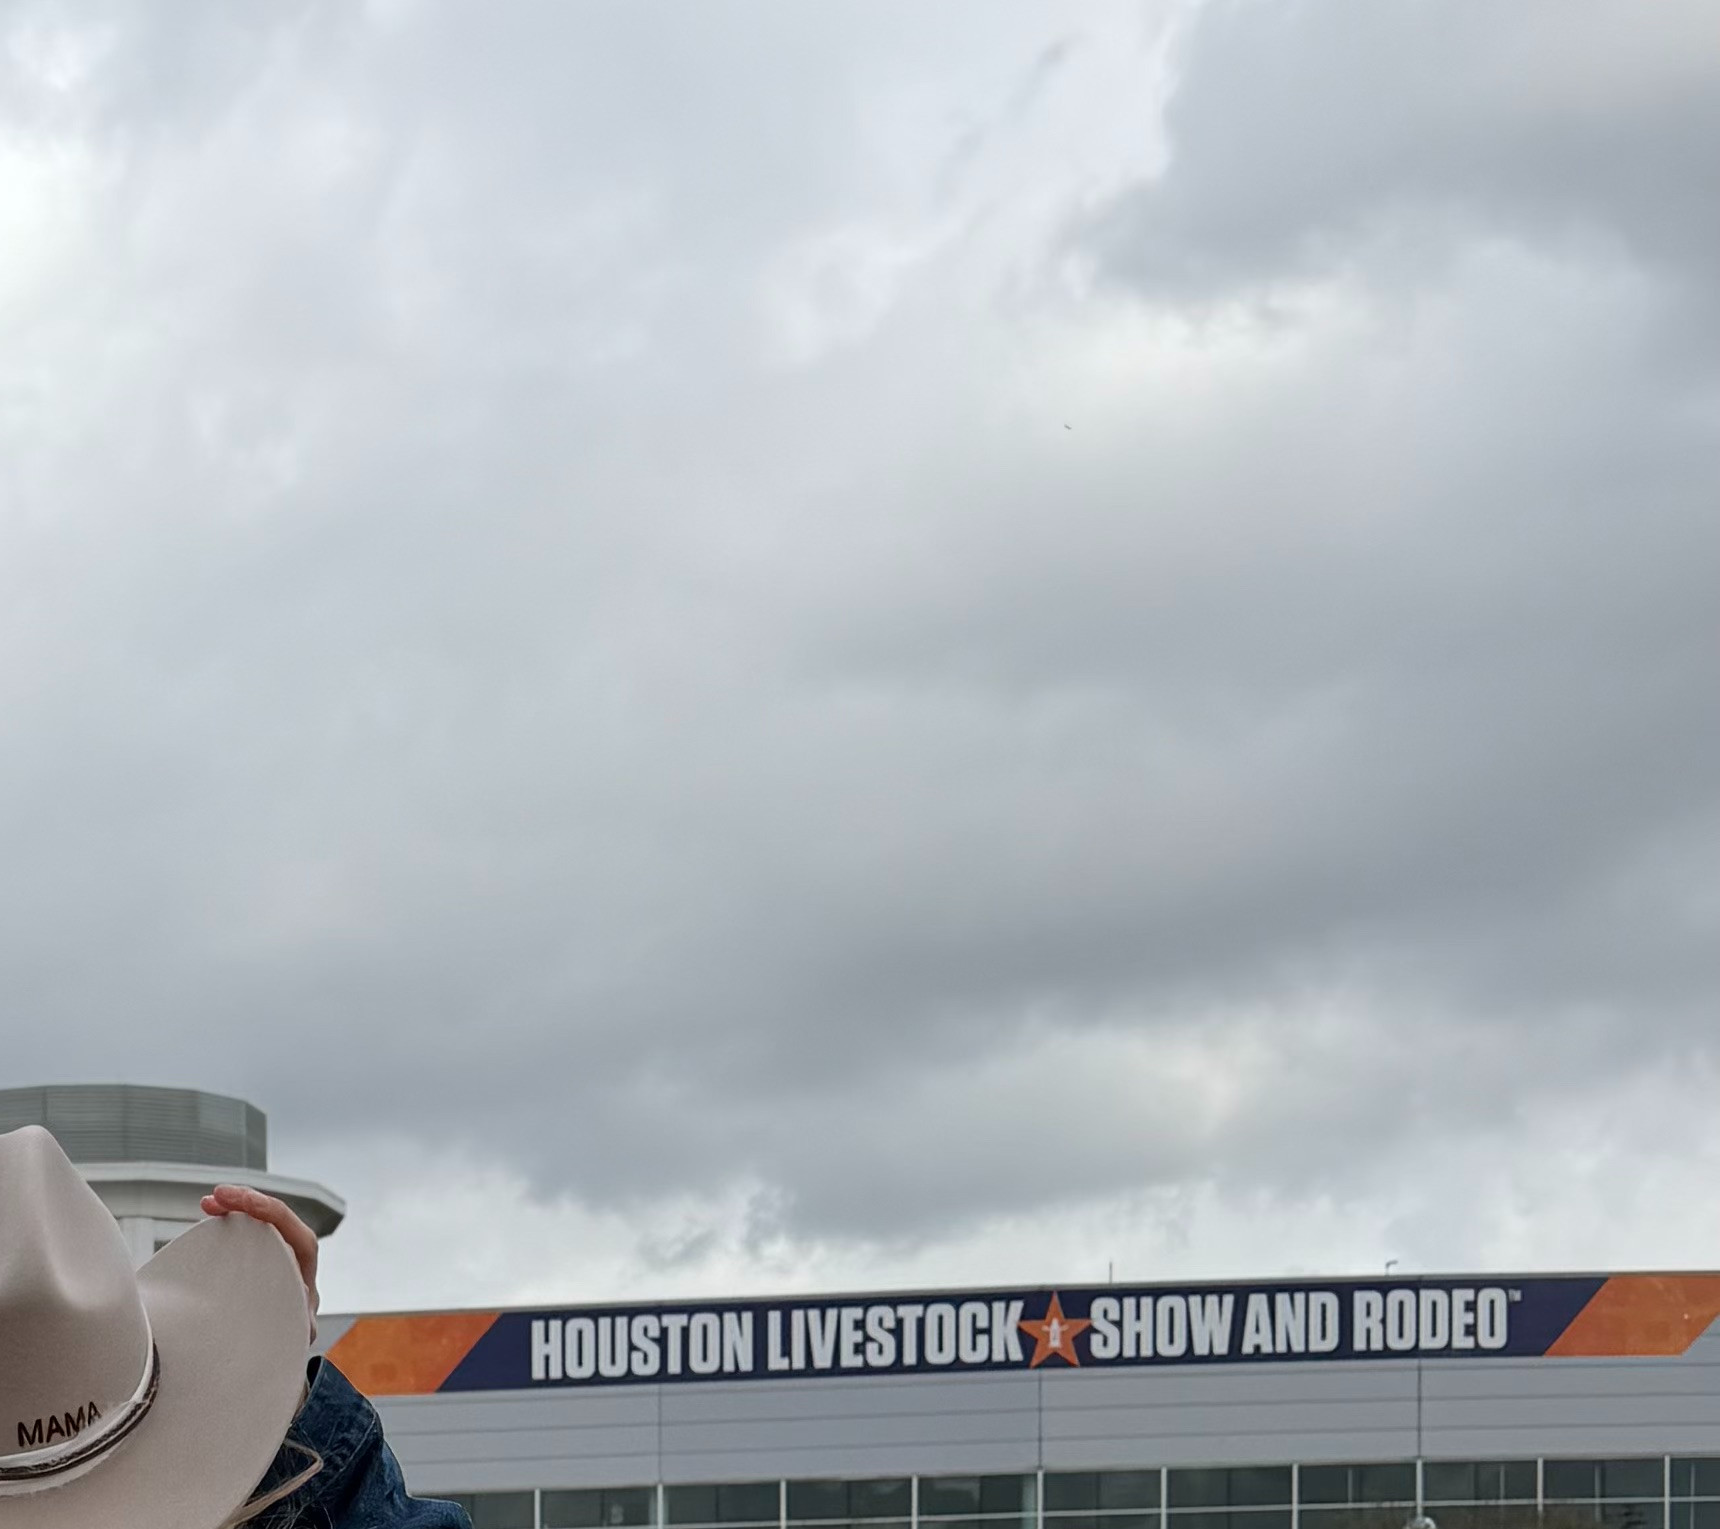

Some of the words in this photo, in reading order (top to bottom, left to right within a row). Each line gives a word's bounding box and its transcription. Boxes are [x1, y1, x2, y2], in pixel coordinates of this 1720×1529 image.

[530, 1310, 755, 1381] HOUSTON
[766, 1300, 1025, 1371] LIVESTOCK
[1090, 1293, 1234, 1360] SHOW
[1240, 1291, 1340, 1356] AND
[1352, 1287, 1509, 1353] RODEO
[16, 1401, 102, 1448] MAMA
